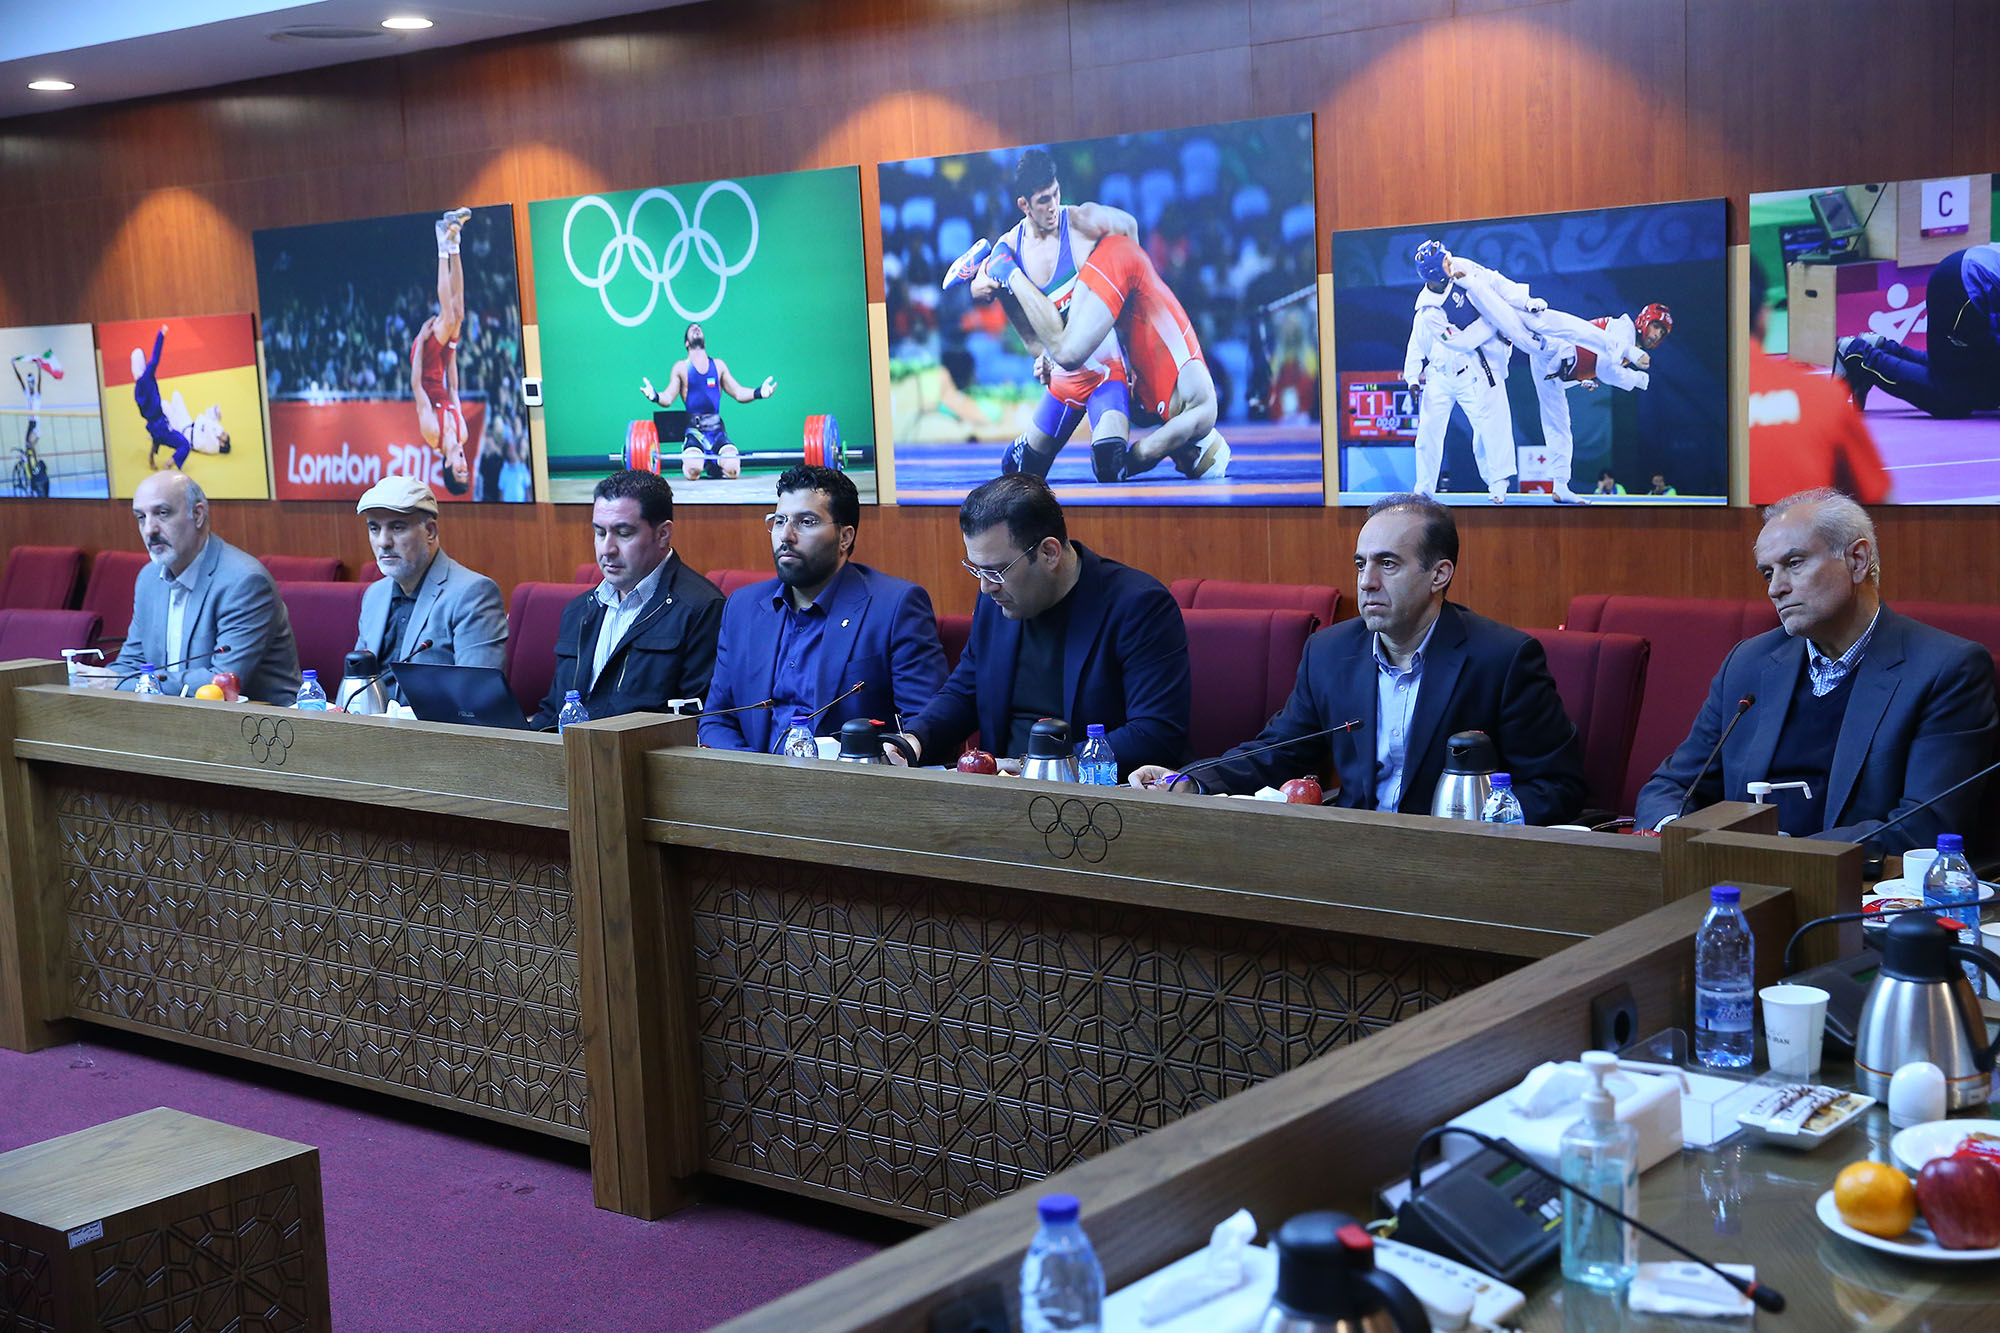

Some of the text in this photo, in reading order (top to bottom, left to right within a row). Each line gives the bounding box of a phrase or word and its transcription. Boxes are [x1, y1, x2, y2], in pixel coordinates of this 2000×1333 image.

[1939, 191, 1953, 217] C
[1366, 393, 1414, 416] 1 4
[288, 441, 445, 487] London 2012
